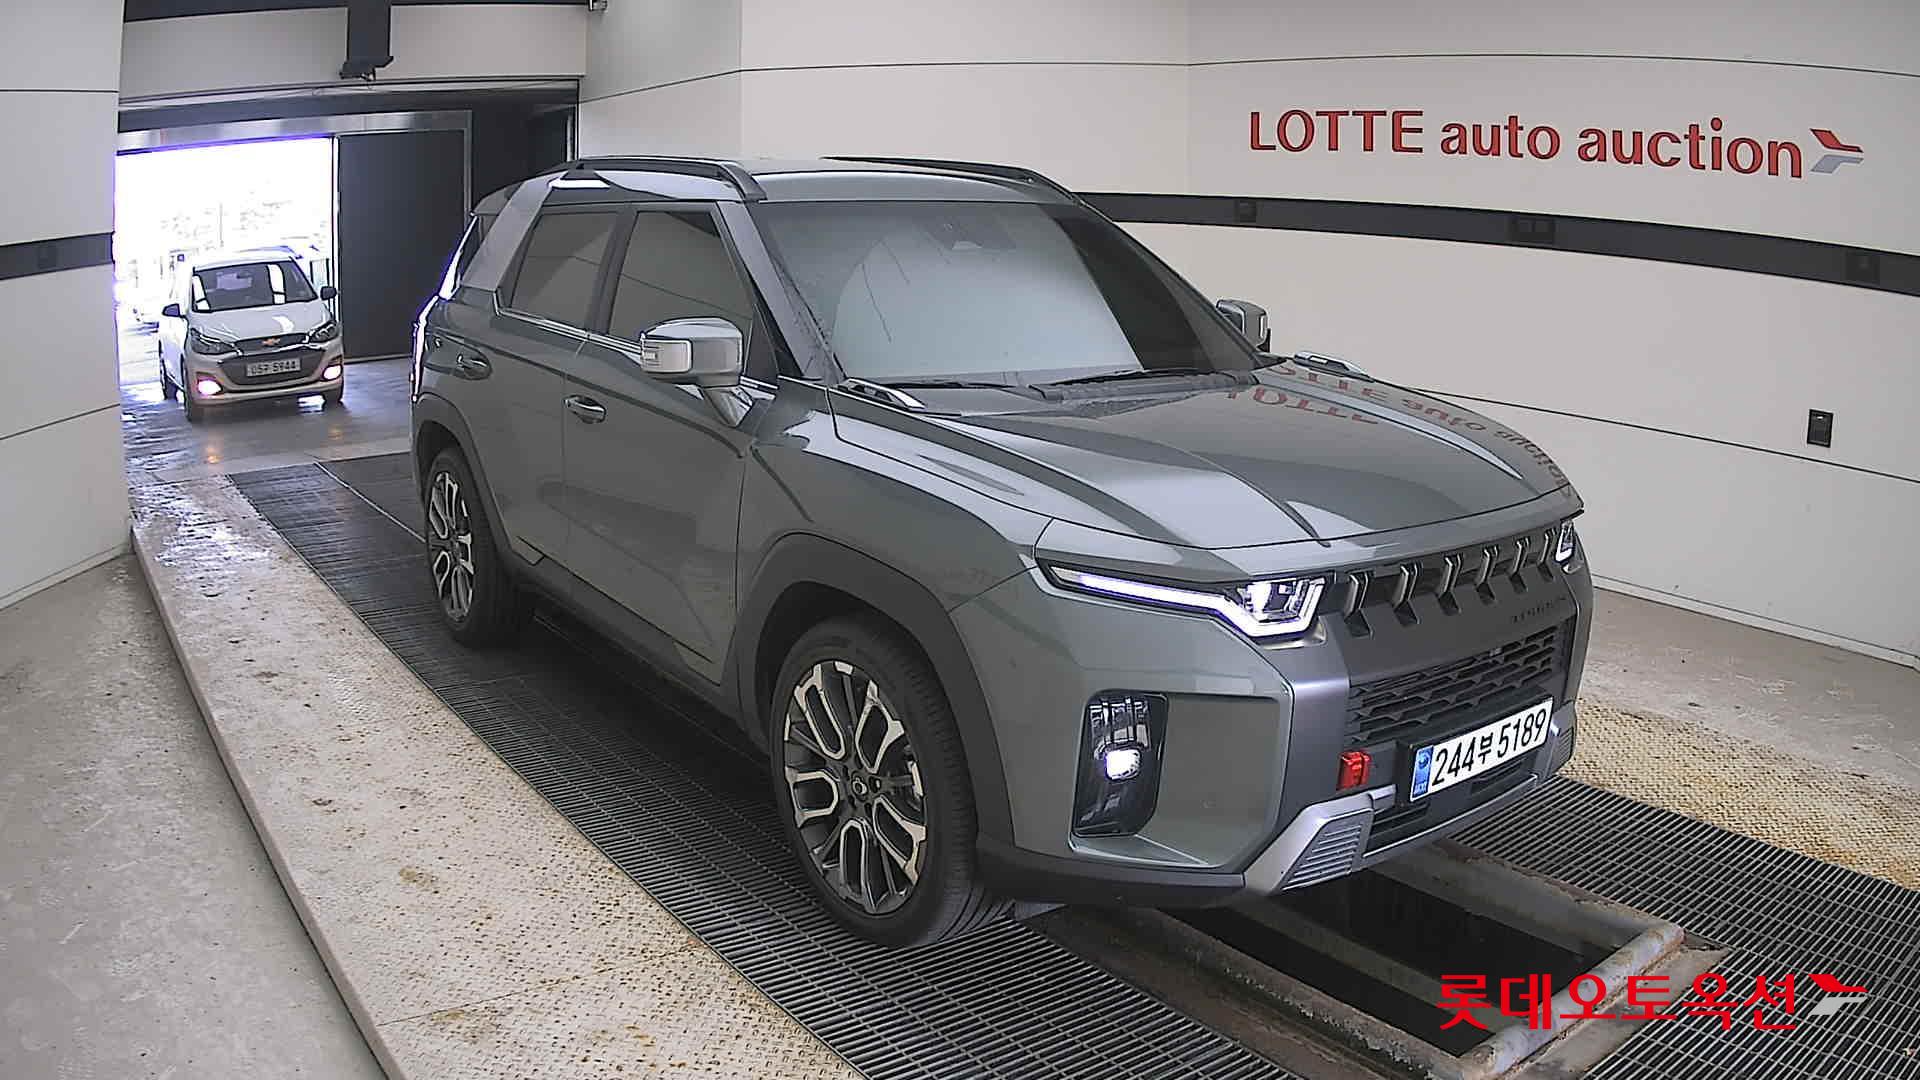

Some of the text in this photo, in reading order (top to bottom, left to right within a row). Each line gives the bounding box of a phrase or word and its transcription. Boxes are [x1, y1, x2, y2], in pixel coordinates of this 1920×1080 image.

[1248, 109, 1803, 179] LOTTE auto auction
[1431, 707, 1547, 787] 244부 5189
